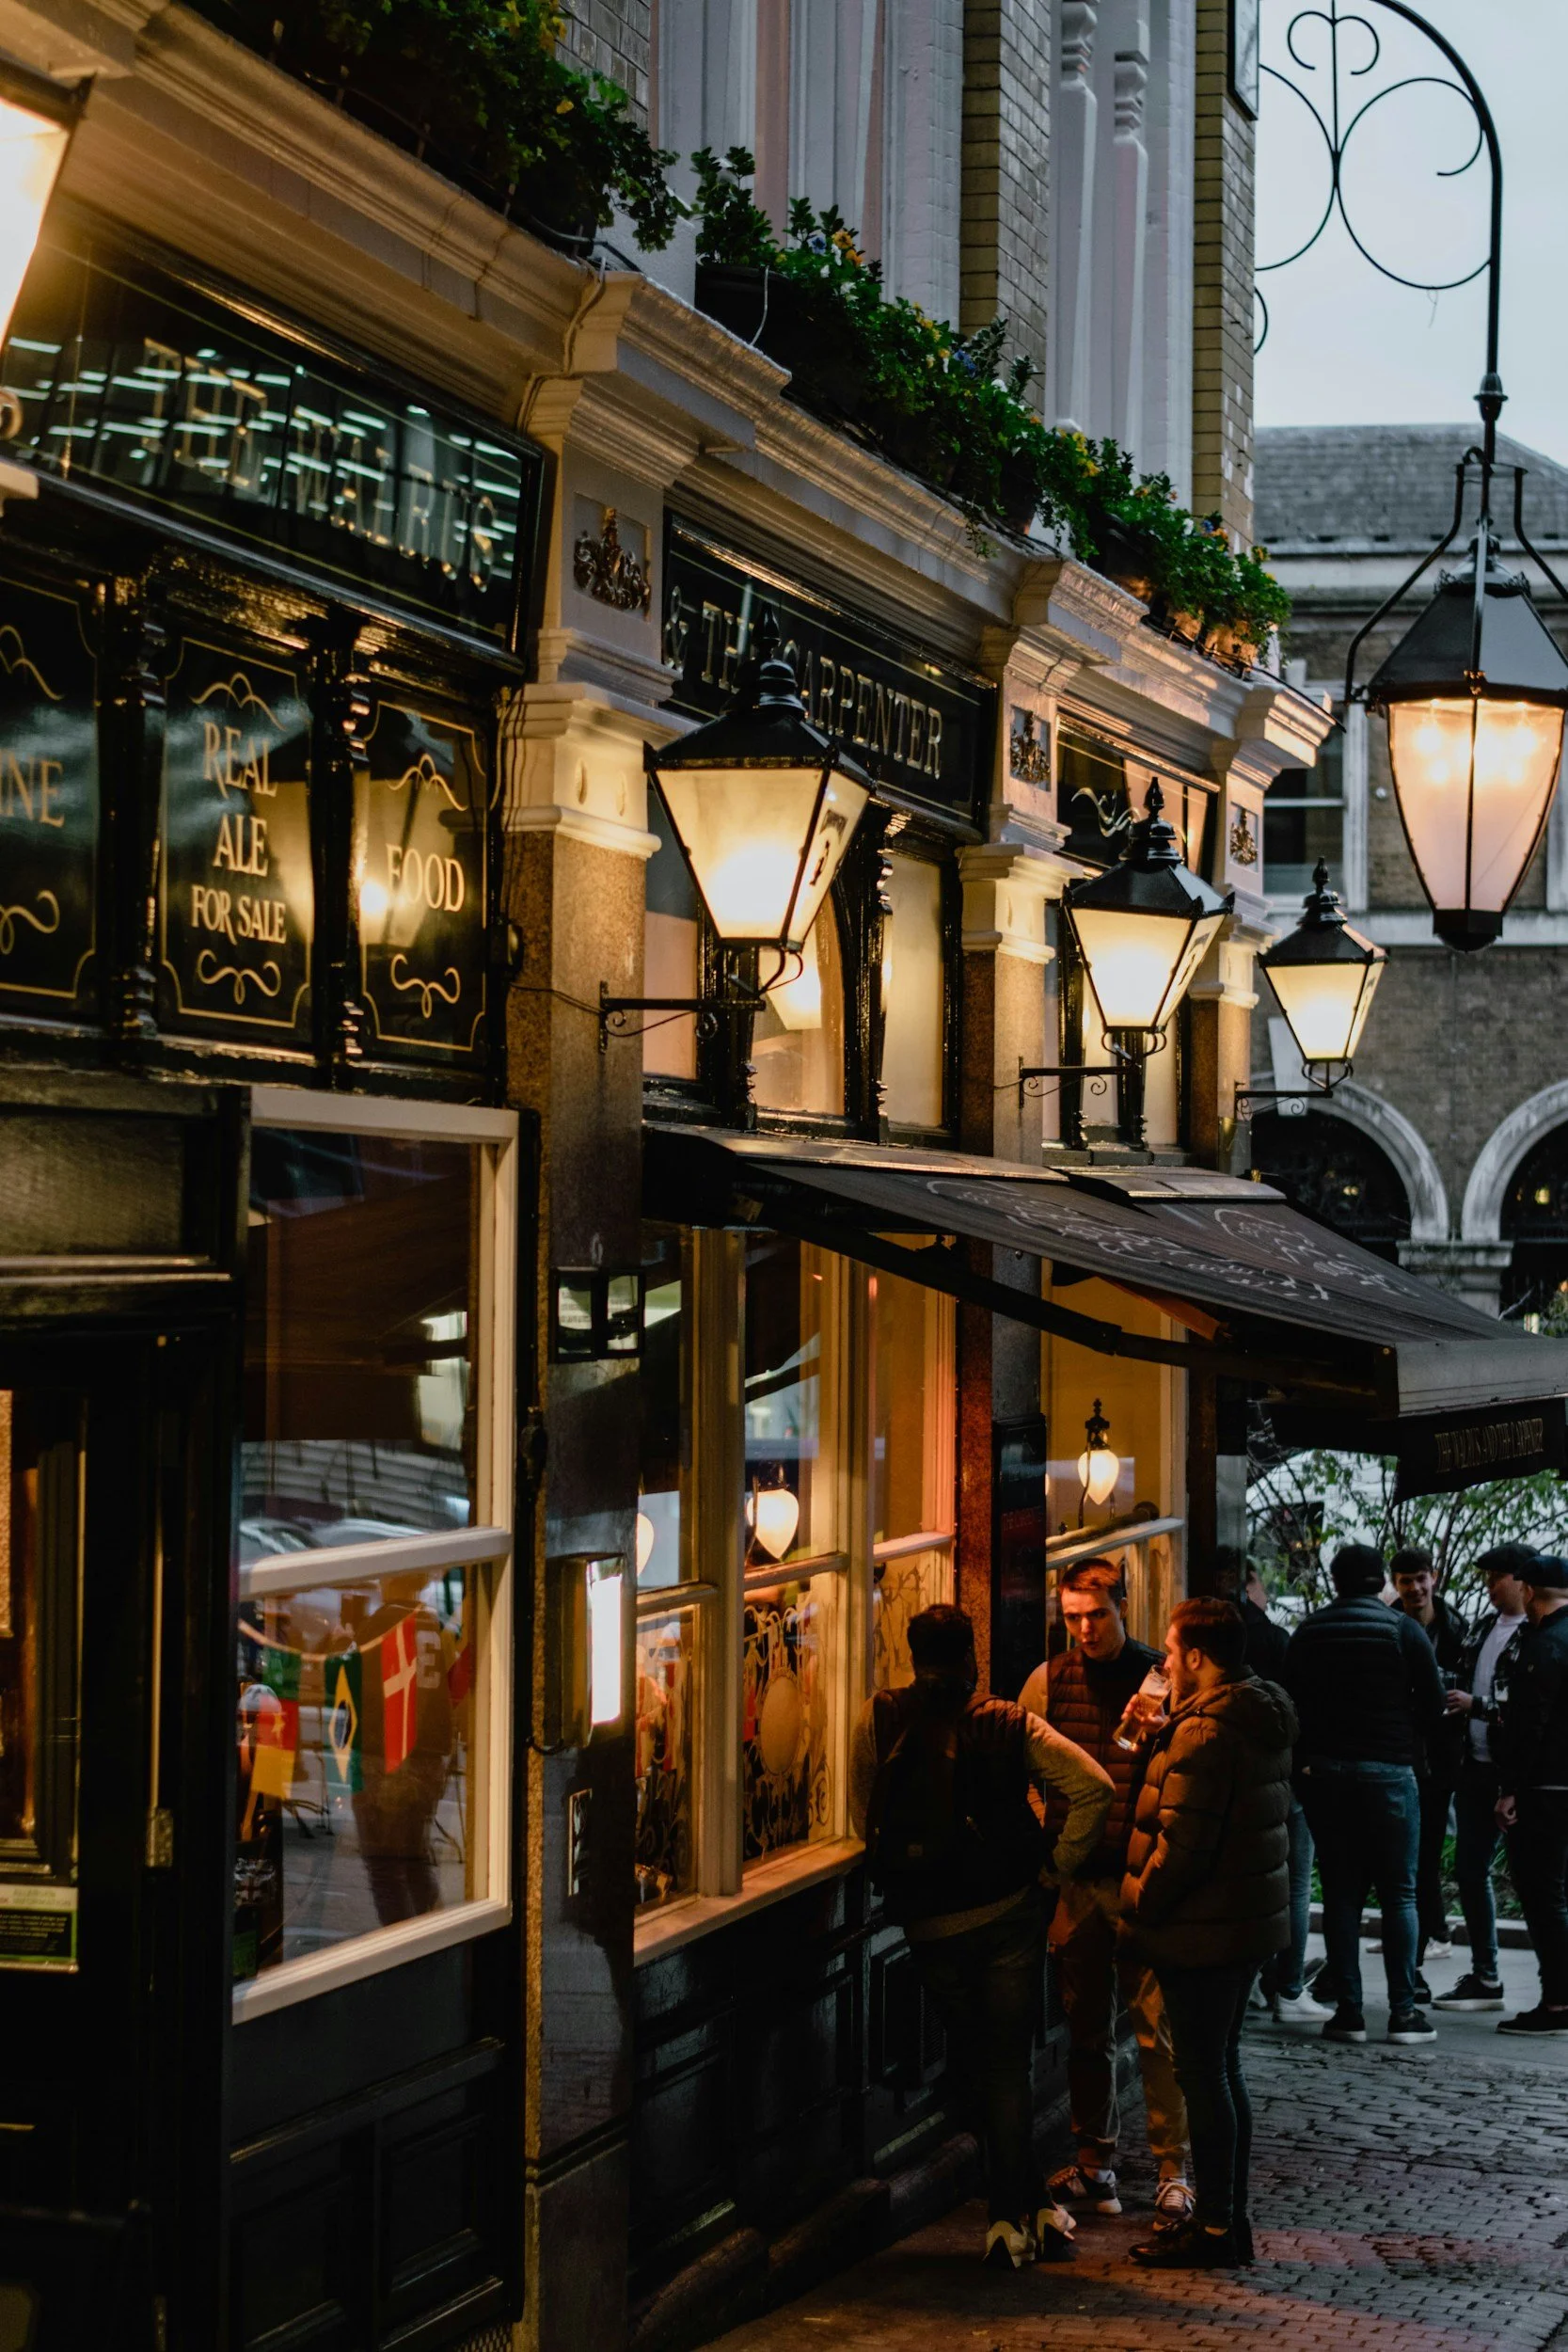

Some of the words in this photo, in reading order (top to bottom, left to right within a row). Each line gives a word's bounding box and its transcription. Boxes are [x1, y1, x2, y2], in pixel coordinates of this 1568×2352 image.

[664, 585, 695, 673] &
[203, 721, 277, 798] REAL
[213, 813, 269, 877] ALE
[386, 843, 465, 912] FOOD
[191, 884, 238, 946] FOR
[237, 896, 287, 944] SALE
